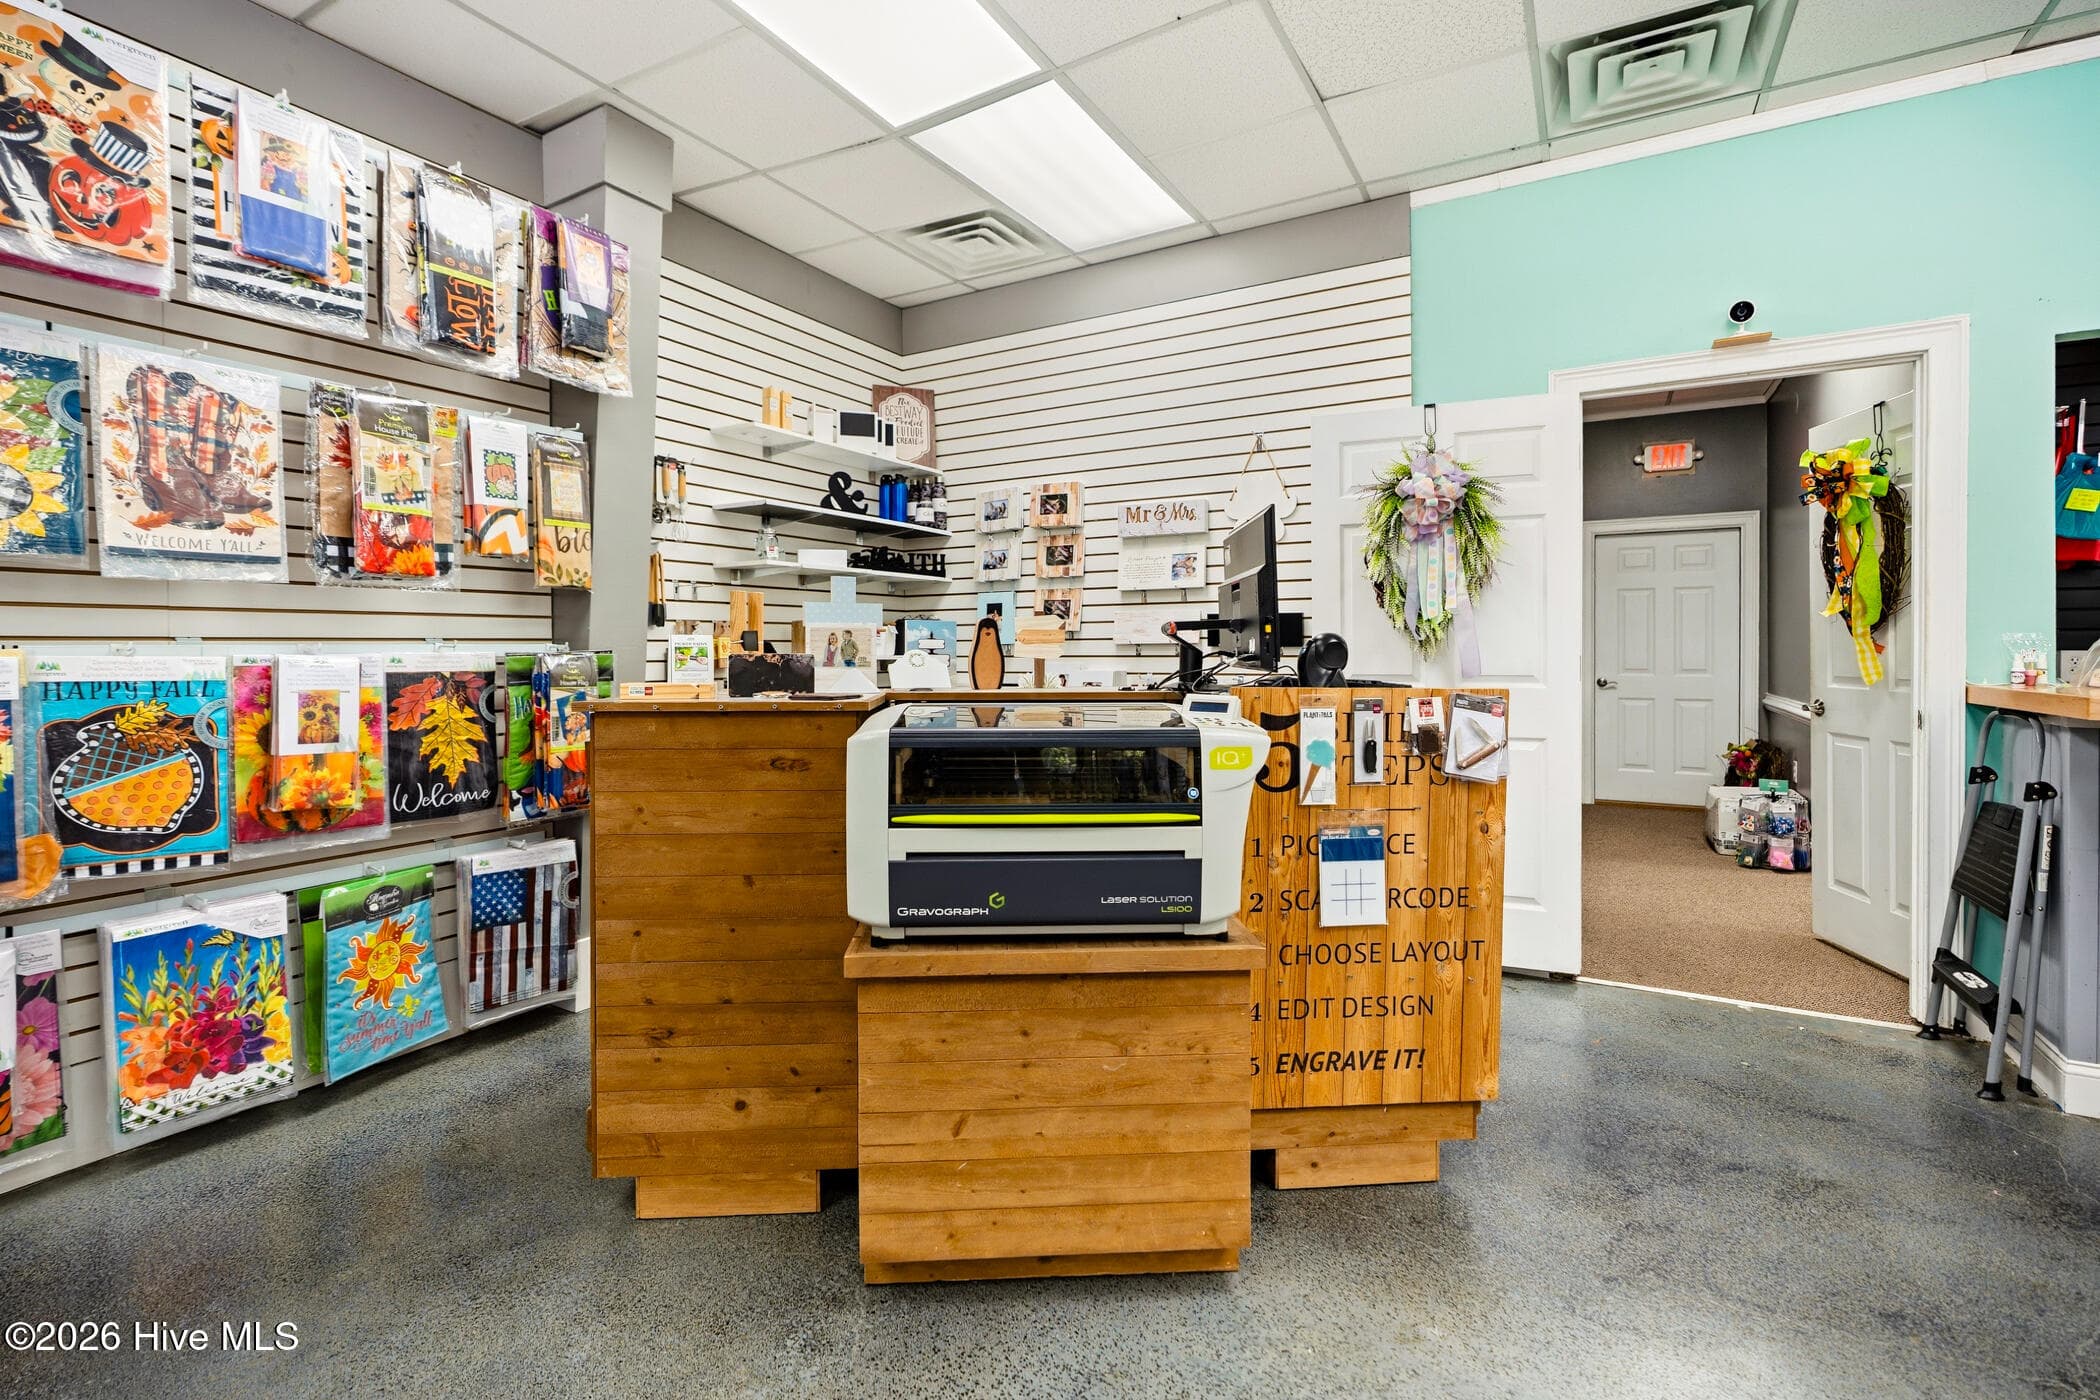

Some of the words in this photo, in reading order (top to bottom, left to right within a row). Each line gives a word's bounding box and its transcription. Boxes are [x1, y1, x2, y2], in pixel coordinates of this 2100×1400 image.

[0, 32, 33, 51] APPY
[885, 405, 903, 417] BEST
[903, 406, 923, 420] WAY
[374, 424, 398, 437] House
[400, 430, 418, 441] Flag
[1126, 505, 1151, 524] Mr
[1153, 503, 1167, 521] &
[135, 532, 212, 551] WELCOME
[219, 538, 253, 553] Y'ALL
[42, 681, 138, 702] HAPPY
[150, 680, 215, 698] FALL
[393, 782, 491, 813] Welcome
[1251, 838, 1263, 857] 1
[1281, 834, 1319, 856] PIC
[1139, 895, 1193, 903] SOLUTION
[1249, 892, 1264, 913] 2
[1280, 888, 1321, 911] SCA
[1388, 887, 1470, 909] RCODE
[1279, 942, 1382, 966] CHOOSE
[1391, 940, 1485, 963] LAYOUT
[1278, 998, 1335, 1020] EDIT
[1342, 995, 1434, 1019] DESIGN
[1275, 1049, 1388, 1074] ENGRAVE
[1393, 1048, 1426, 1070] IT!
